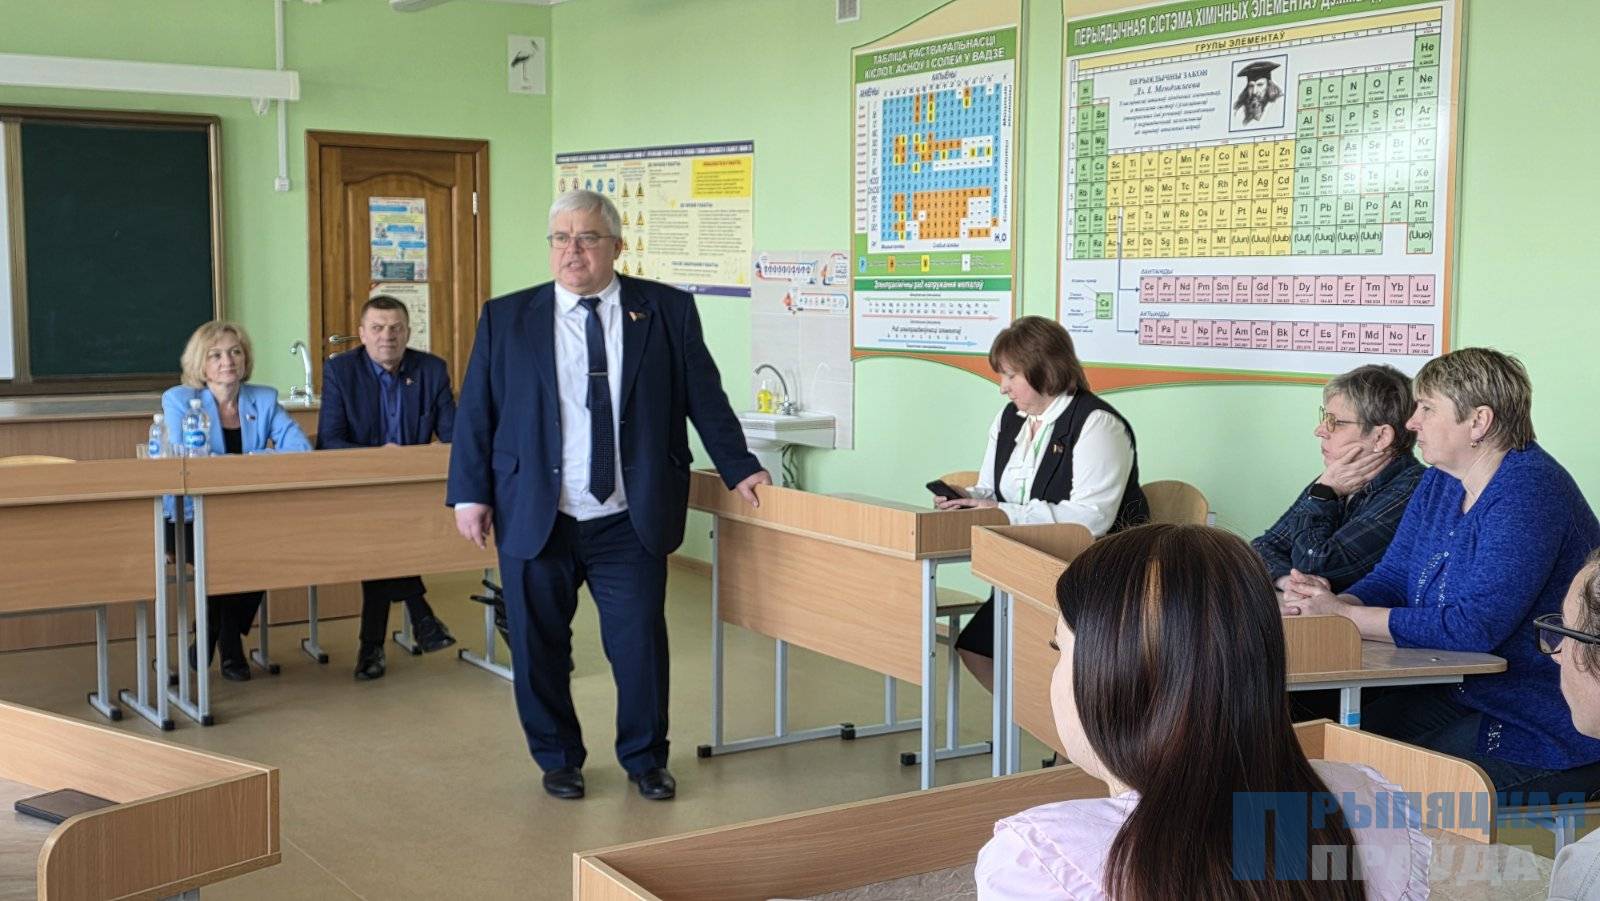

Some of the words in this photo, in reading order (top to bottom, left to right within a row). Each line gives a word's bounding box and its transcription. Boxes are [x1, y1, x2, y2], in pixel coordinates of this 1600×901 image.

[1074, 18, 1146, 46] ПЕРЫЯДЫЧНАЯ
[1149, 11, 1194, 34] СІСТЭМА
[1196, 1, 1249, 26] ХІМІЧНЫХ
[1196, 41, 1227, 52] ГРУПЫ
[1229, 32, 1286, 48] ЭЛЕМЕНТАЎ
[872, 50, 908, 65] ТАБЛІЦА
[908, 36, 996, 58] РАСТВАРАЛЬНАСЦІ
[1420, 42, 1434, 52] He
[930, 54, 962, 68] СОЛЕЙ
[972, 47, 1005, 62] ВАДЗЕ
[1183, 69, 1208, 78] ЗАКОН
[1398, 77, 1404, 86] F
[1420, 74, 1433, 83] Ne
[1350, 82, 1357, 90] N
[1373, 79, 1381, 88] O
[1306, 86, 1312, 95] B
[1328, 84, 1334, 93] C
[1372, 110, 1379, 118] S
[1395, 107, 1405, 116] Cl
[1419, 106, 1430, 115] Ar
[1303, 116, 1312, 124] Al
[1326, 114, 1334, 122] Si
[1349, 112, 1356, 120] P
[1369, 141, 1381, 149] Se
[1417, 136, 1429, 145] Kr
[1300, 145, 1312, 154] Ga
[1322, 144, 1334, 152] Ge
[1344, 142, 1357, 151] As
[1280, 147, 1290, 156] Zn
[1130, 159, 1136, 167] Ti
[1344, 172, 1356, 181] Sb
[1416, 168, 1429, 177] Xe
[1257, 178, 1268, 187] Ag
[1278, 176, 1289, 184] Cd
[1301, 175, 1309, 183] In
[1321, 174, 1333, 182] Sn
[1218, 180, 1228, 188] Rh
[1238, 179, 1248, 187] Pd
[1300, 204, 1308, 212] Tl
[1320, 203, 1332, 212] Pb
[1344, 202, 1354, 211] Bi
[1366, 201, 1378, 210] Po
[1391, 200, 1401, 209] At
[1414, 200, 1428, 208] Rn
[1277, 206, 1288, 215] Hg
[1315, 233, 1335, 243] (Uuq)
[1338, 232, 1358, 242] (Uup)
[1360, 231, 1382, 241] (Uuh)
[1409, 231, 1432, 241] (Uuo)
[1161, 237, 1170, 246] Sg
[1256, 283, 1268, 291] Gd
[1278, 282, 1288, 291] Tb
[1299, 282, 1310, 292] Dy
[1321, 282, 1333, 291] Ho
[1366, 282, 1380, 291] Tm
[1391, 282, 1404, 291] Yb
[1416, 282, 1429, 291] Lu
[1198, 327, 1208, 335] Np
[1277, 328, 1288, 336] Bk
[1299, 329, 1309, 337] Cf
[1341, 330, 1356, 339] Fm
[1365, 331, 1379, 339] Md
[1390, 331, 1403, 340] No
[1416, 332, 1426, 340] Lr
